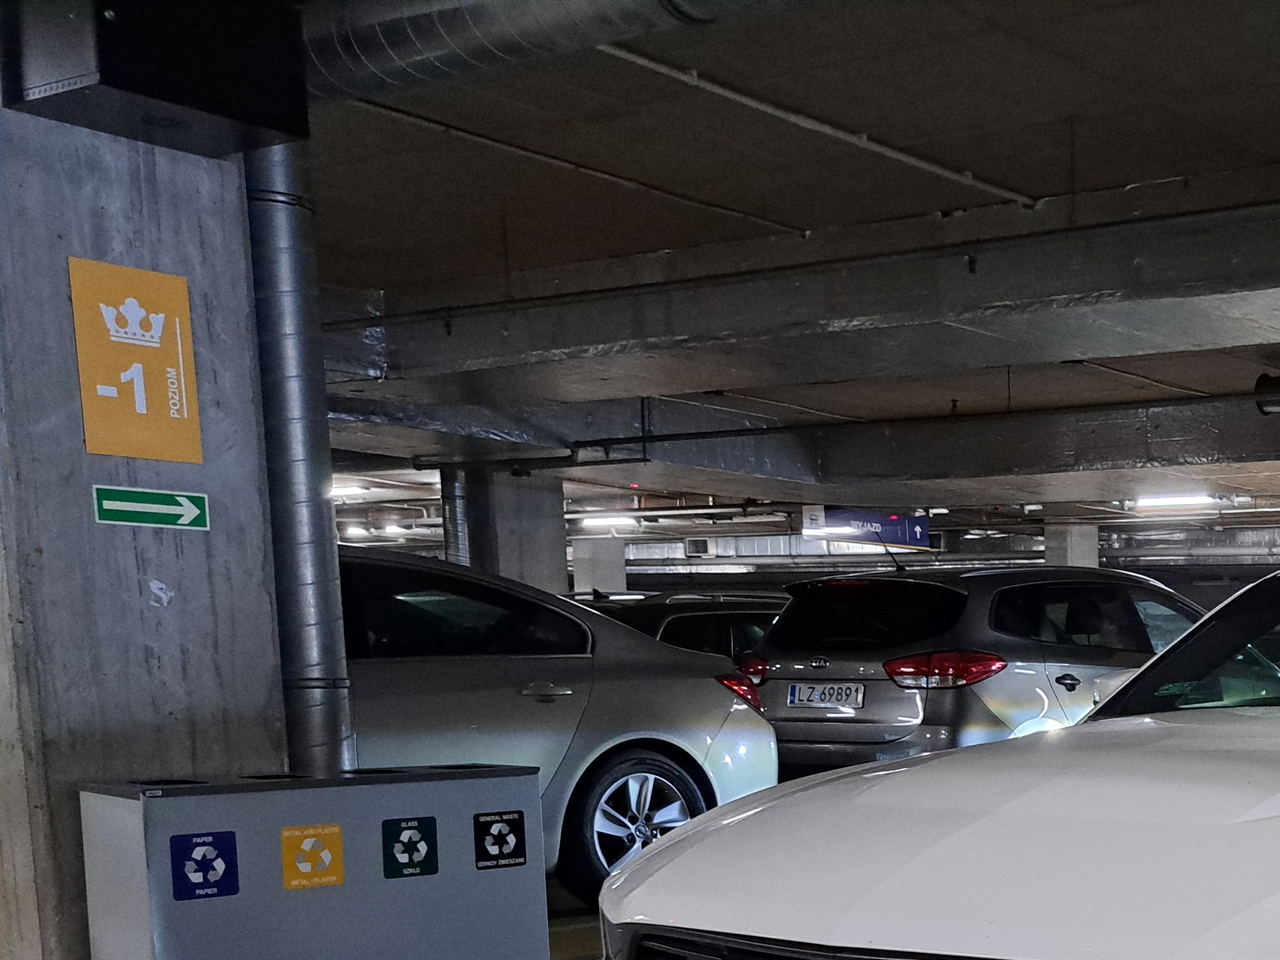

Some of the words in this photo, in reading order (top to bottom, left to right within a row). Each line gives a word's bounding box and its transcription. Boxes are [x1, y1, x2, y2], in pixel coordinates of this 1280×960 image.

[97, 363, 147, 415] -1
[166, 367, 181, 419] POZIOM
[850, 520, 882, 532] WYJAZD
[798, 686, 816, 703] LZ
[820, 686, 859, 703] 69891
[401, 820, 419, 828] GLASS
[193, 836, 213, 844] PAPER
[195, 887, 218, 896] PAPIER
